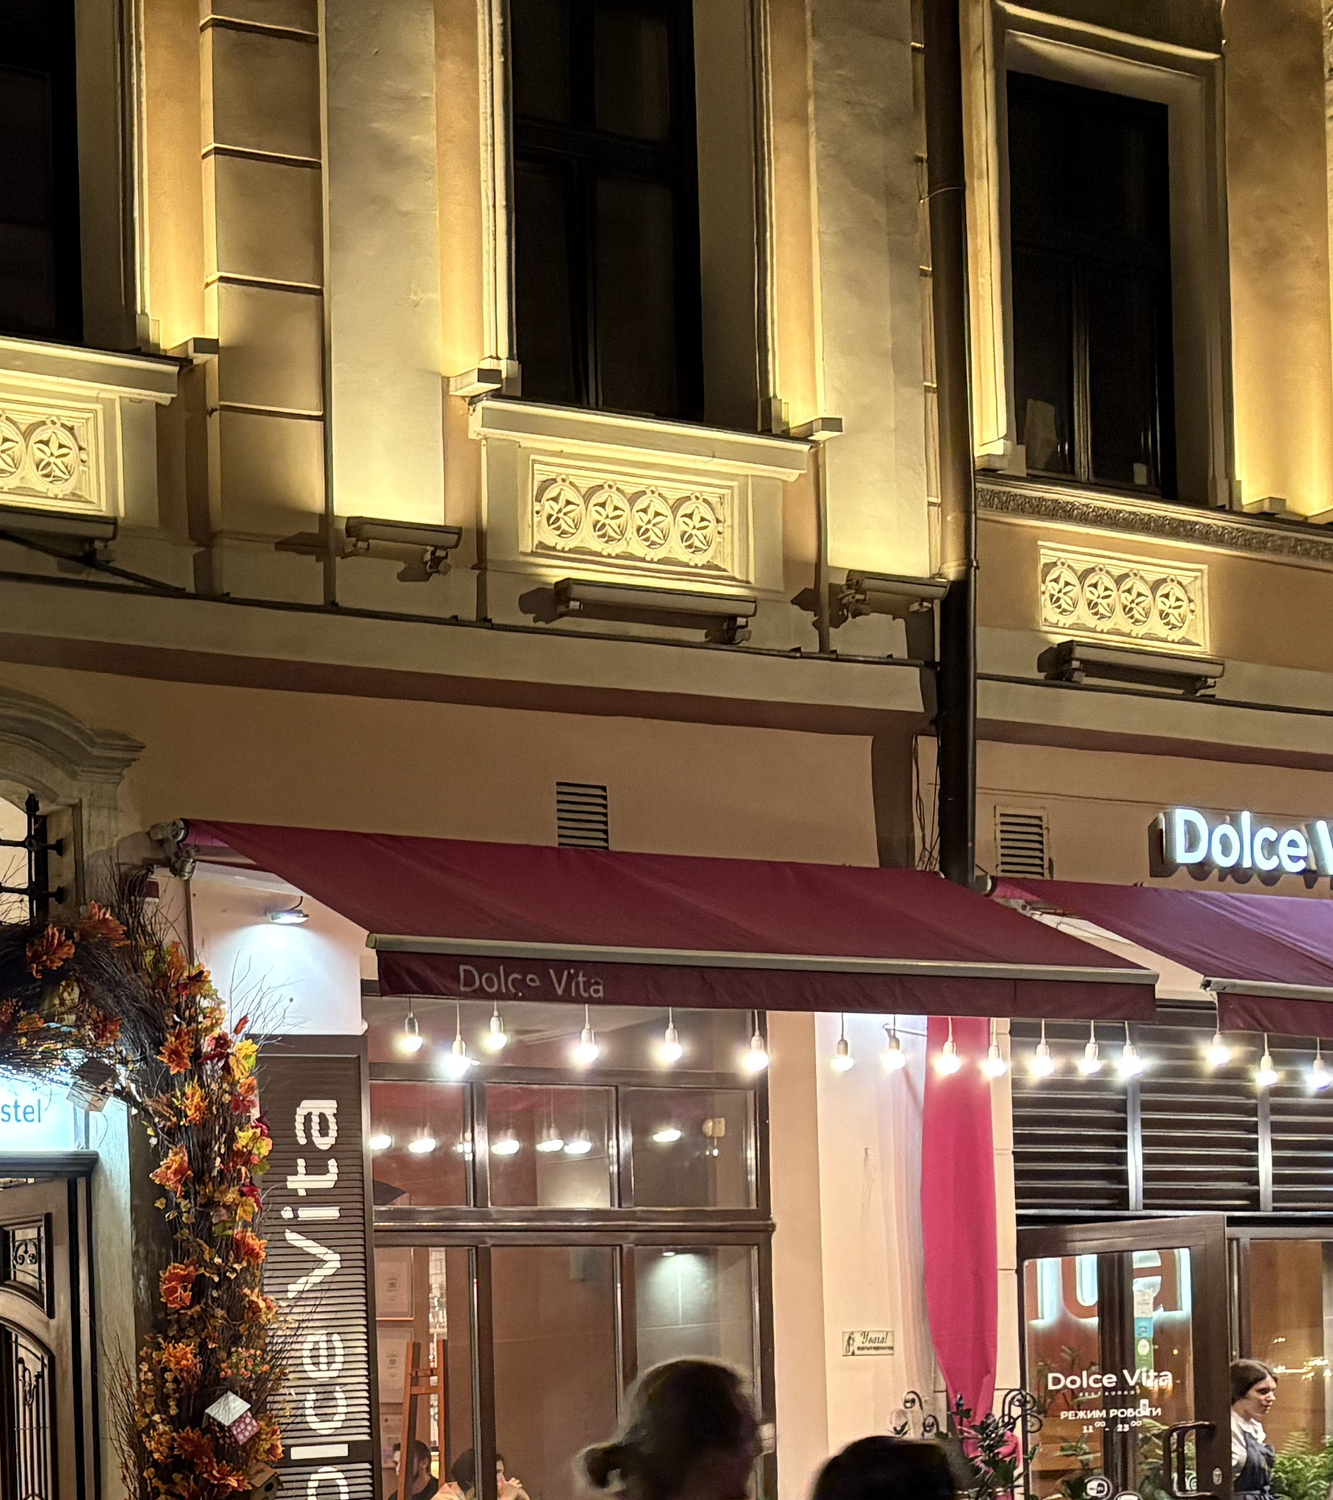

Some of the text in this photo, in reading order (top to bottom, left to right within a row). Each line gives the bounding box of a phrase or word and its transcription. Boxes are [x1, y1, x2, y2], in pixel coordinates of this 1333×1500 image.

[1175, 808, 1308, 873] Dolce
[549, 968, 604, 998] Vita
[281, 1098, 342, 1299] Vita
[1047, 1368, 1173, 1391] Dolce Vita
[1060, 1407, 1162, 1420] РЕЖИМ РОБОТИ
